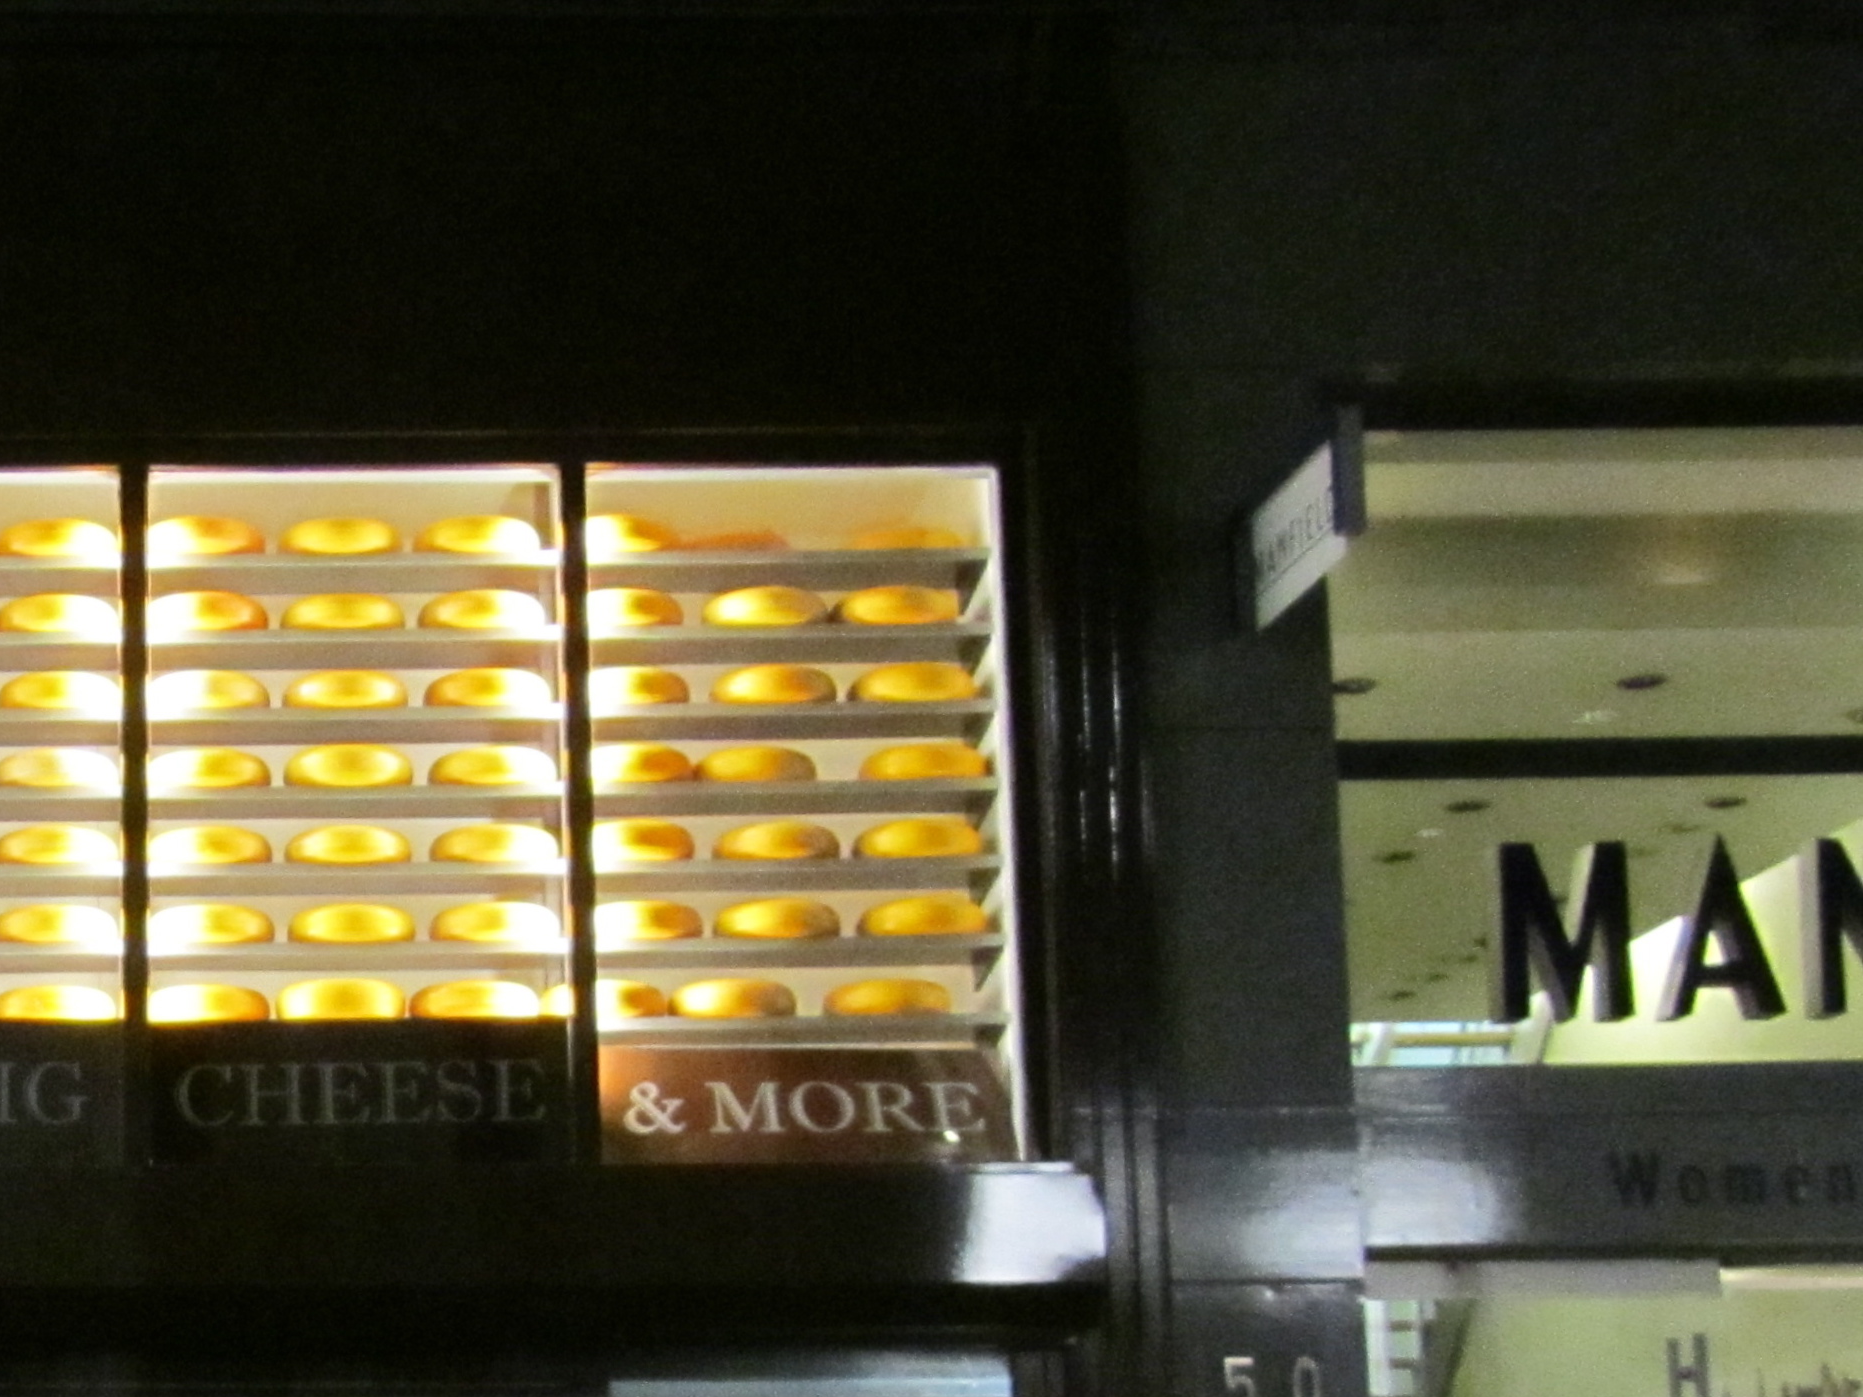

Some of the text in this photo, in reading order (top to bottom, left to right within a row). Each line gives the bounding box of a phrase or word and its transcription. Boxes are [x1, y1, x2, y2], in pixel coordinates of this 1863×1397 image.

[173, 1058, 546, 1128] CHEESE
[623, 1081, 686, 1135] &
[709, 1081, 986, 1135] MORE
